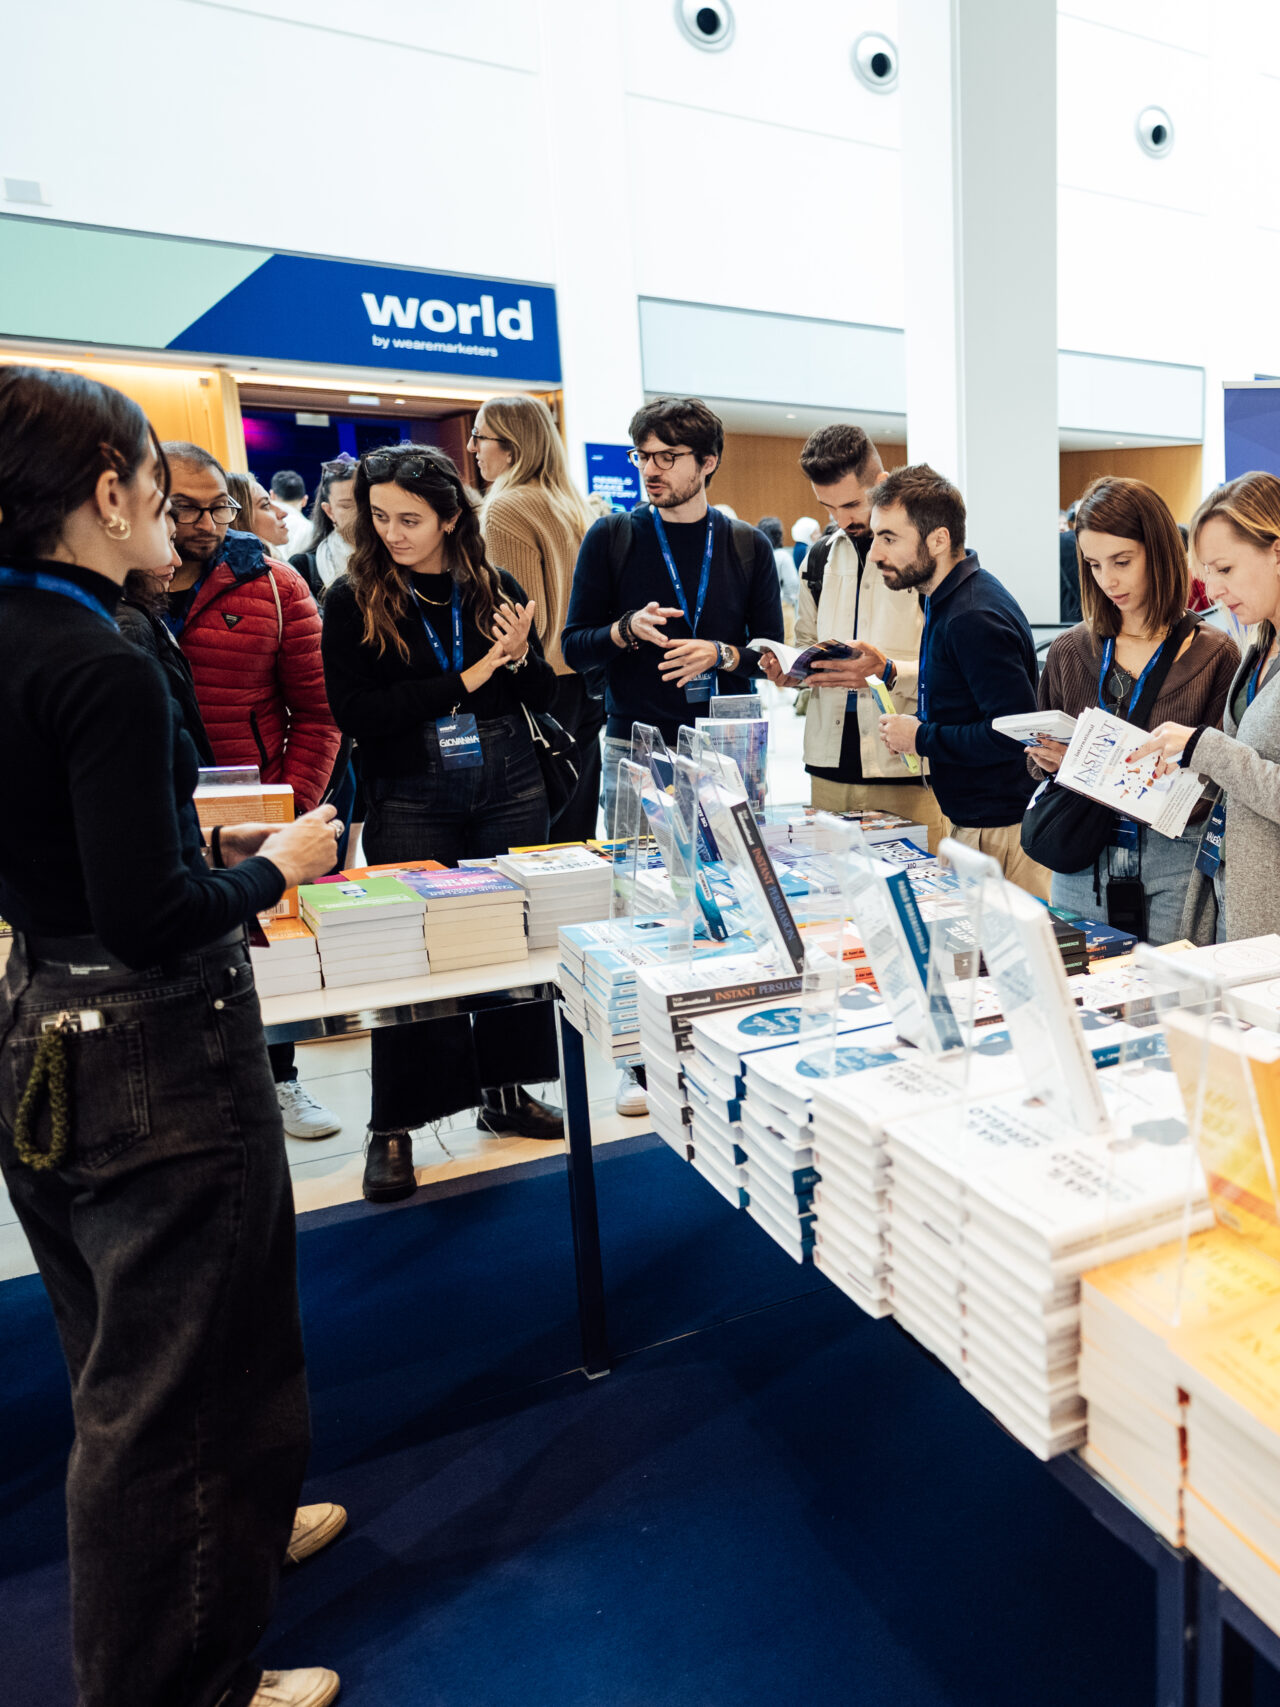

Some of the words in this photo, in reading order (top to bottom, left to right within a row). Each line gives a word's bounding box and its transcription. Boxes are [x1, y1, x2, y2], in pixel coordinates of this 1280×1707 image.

[361, 292, 534, 341] world
[372, 334, 390, 349] by
[392, 338, 499, 357] wearemarketers
[439, 735, 480, 748] GIOVANNA
[752, 847, 775, 886] INSTANT
[768, 885, 796, 941] PERSUASION
[714, 986, 758, 1001] INSTANT
